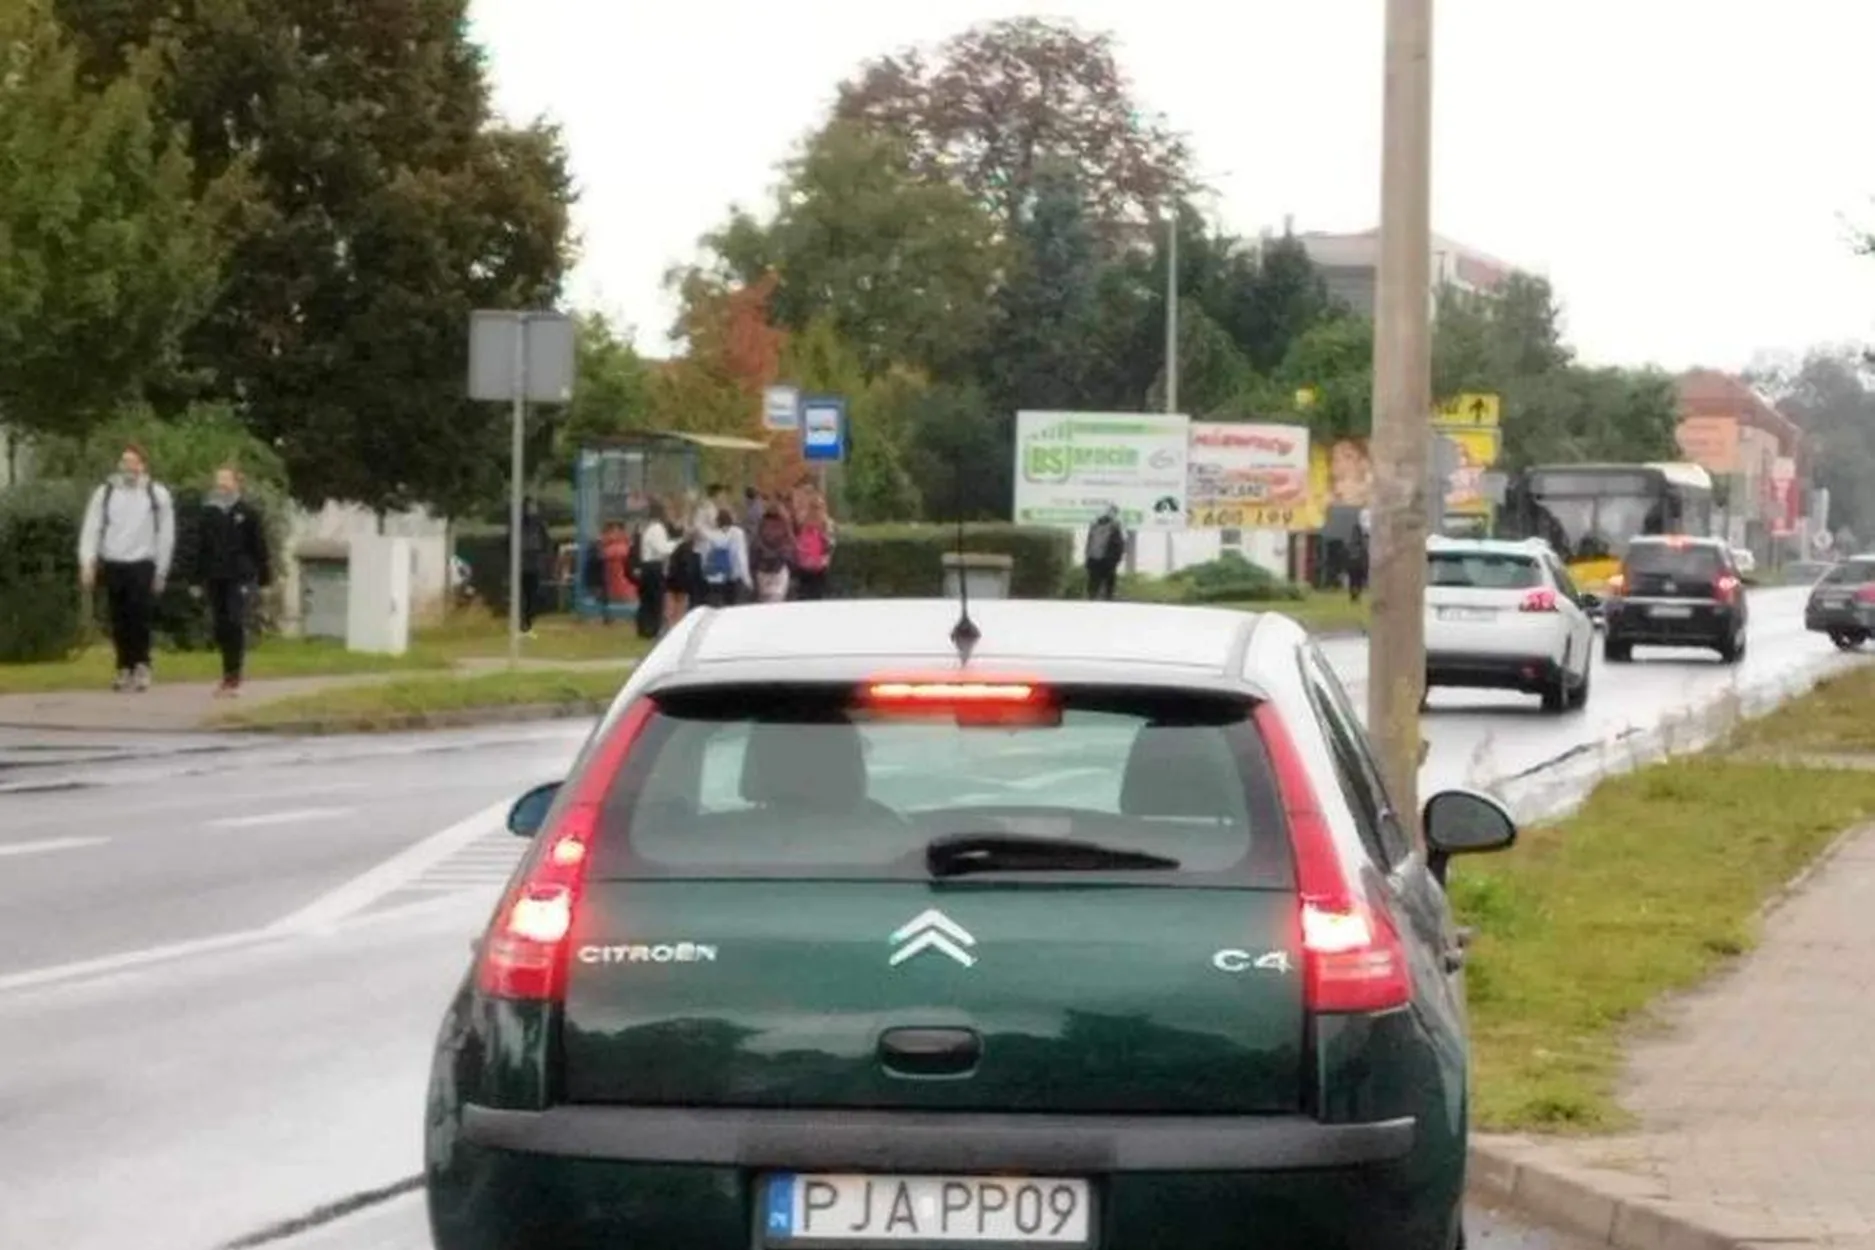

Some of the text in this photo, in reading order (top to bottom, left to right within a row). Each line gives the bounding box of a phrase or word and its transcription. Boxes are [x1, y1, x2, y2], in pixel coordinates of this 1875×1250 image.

[1212, 949, 1293, 974] C4
[802, 1180, 1077, 1235] PJA PP09
